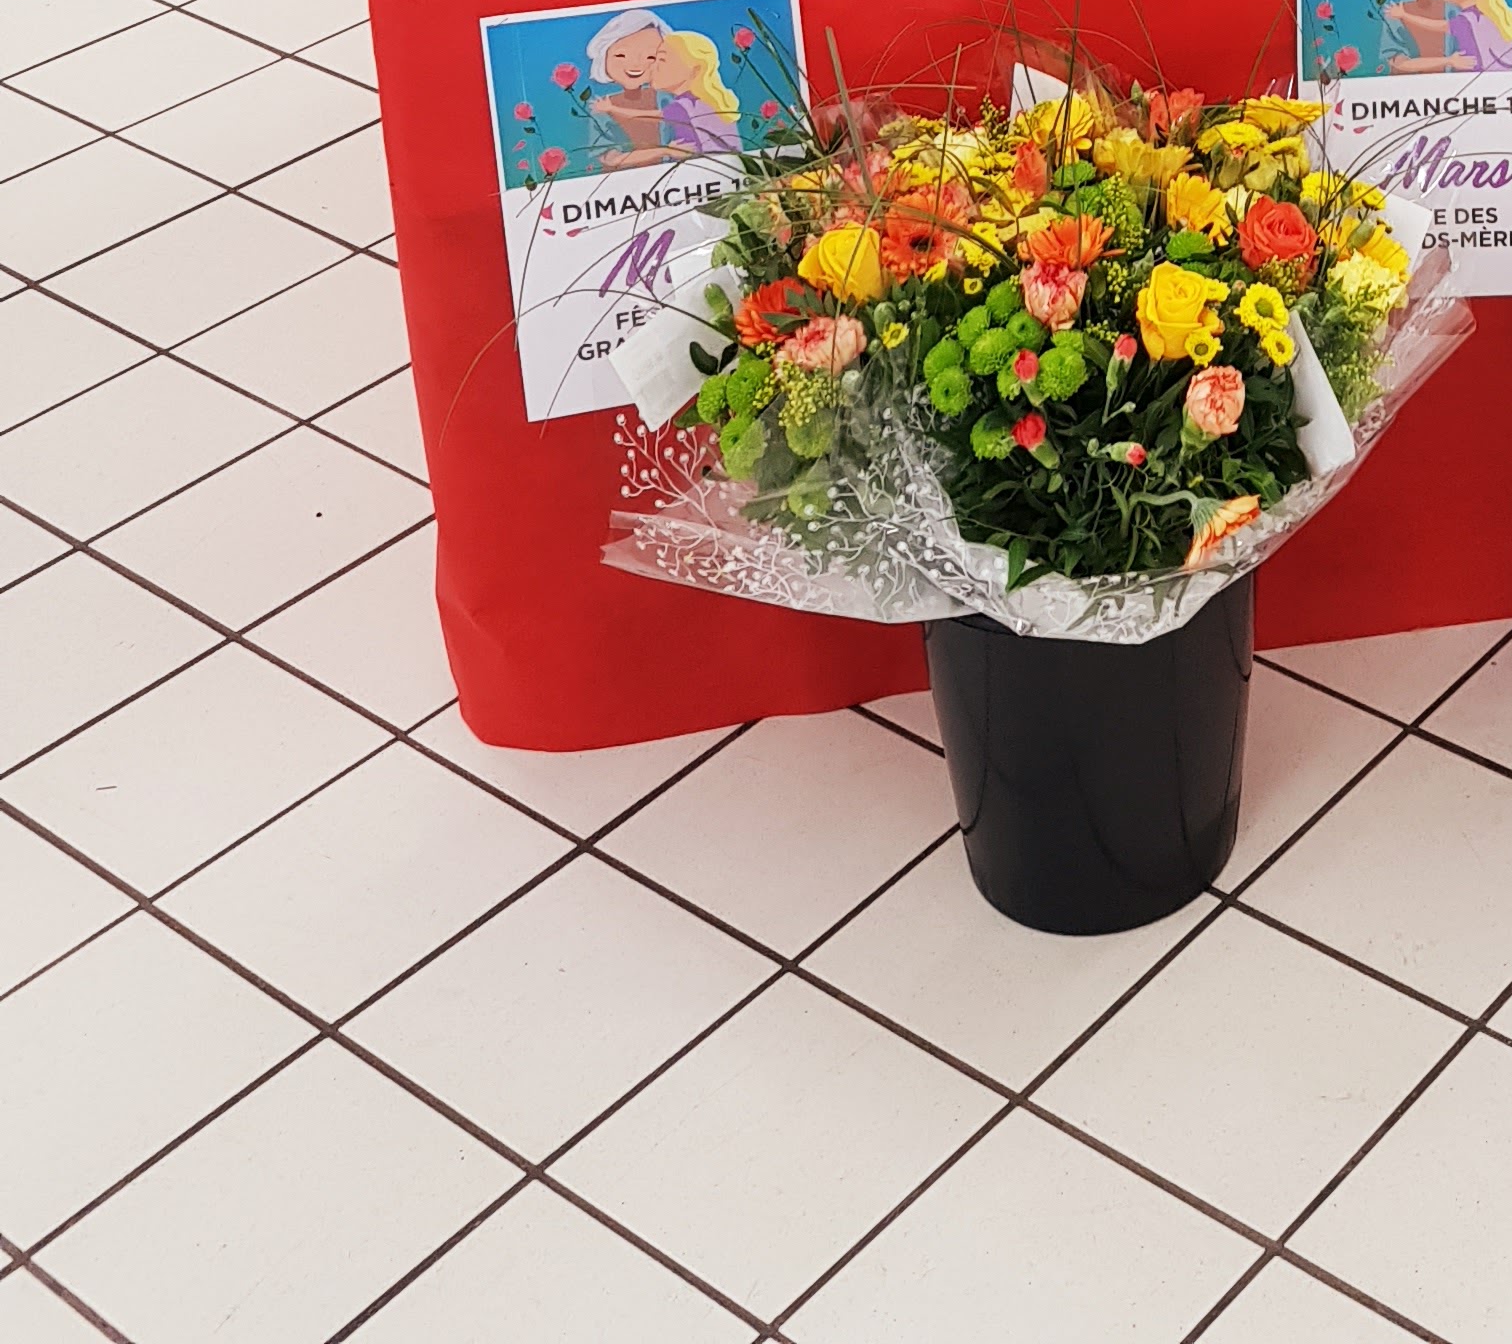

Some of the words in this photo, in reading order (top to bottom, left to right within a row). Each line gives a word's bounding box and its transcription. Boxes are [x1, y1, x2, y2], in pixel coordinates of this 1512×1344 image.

[1351, 96, 1498, 122] DIMANCHE
[562, 181, 722, 224] DIMANCHE
[1454, 207, 1499, 224] DES
[615, 304, 647, 330] FÊ
